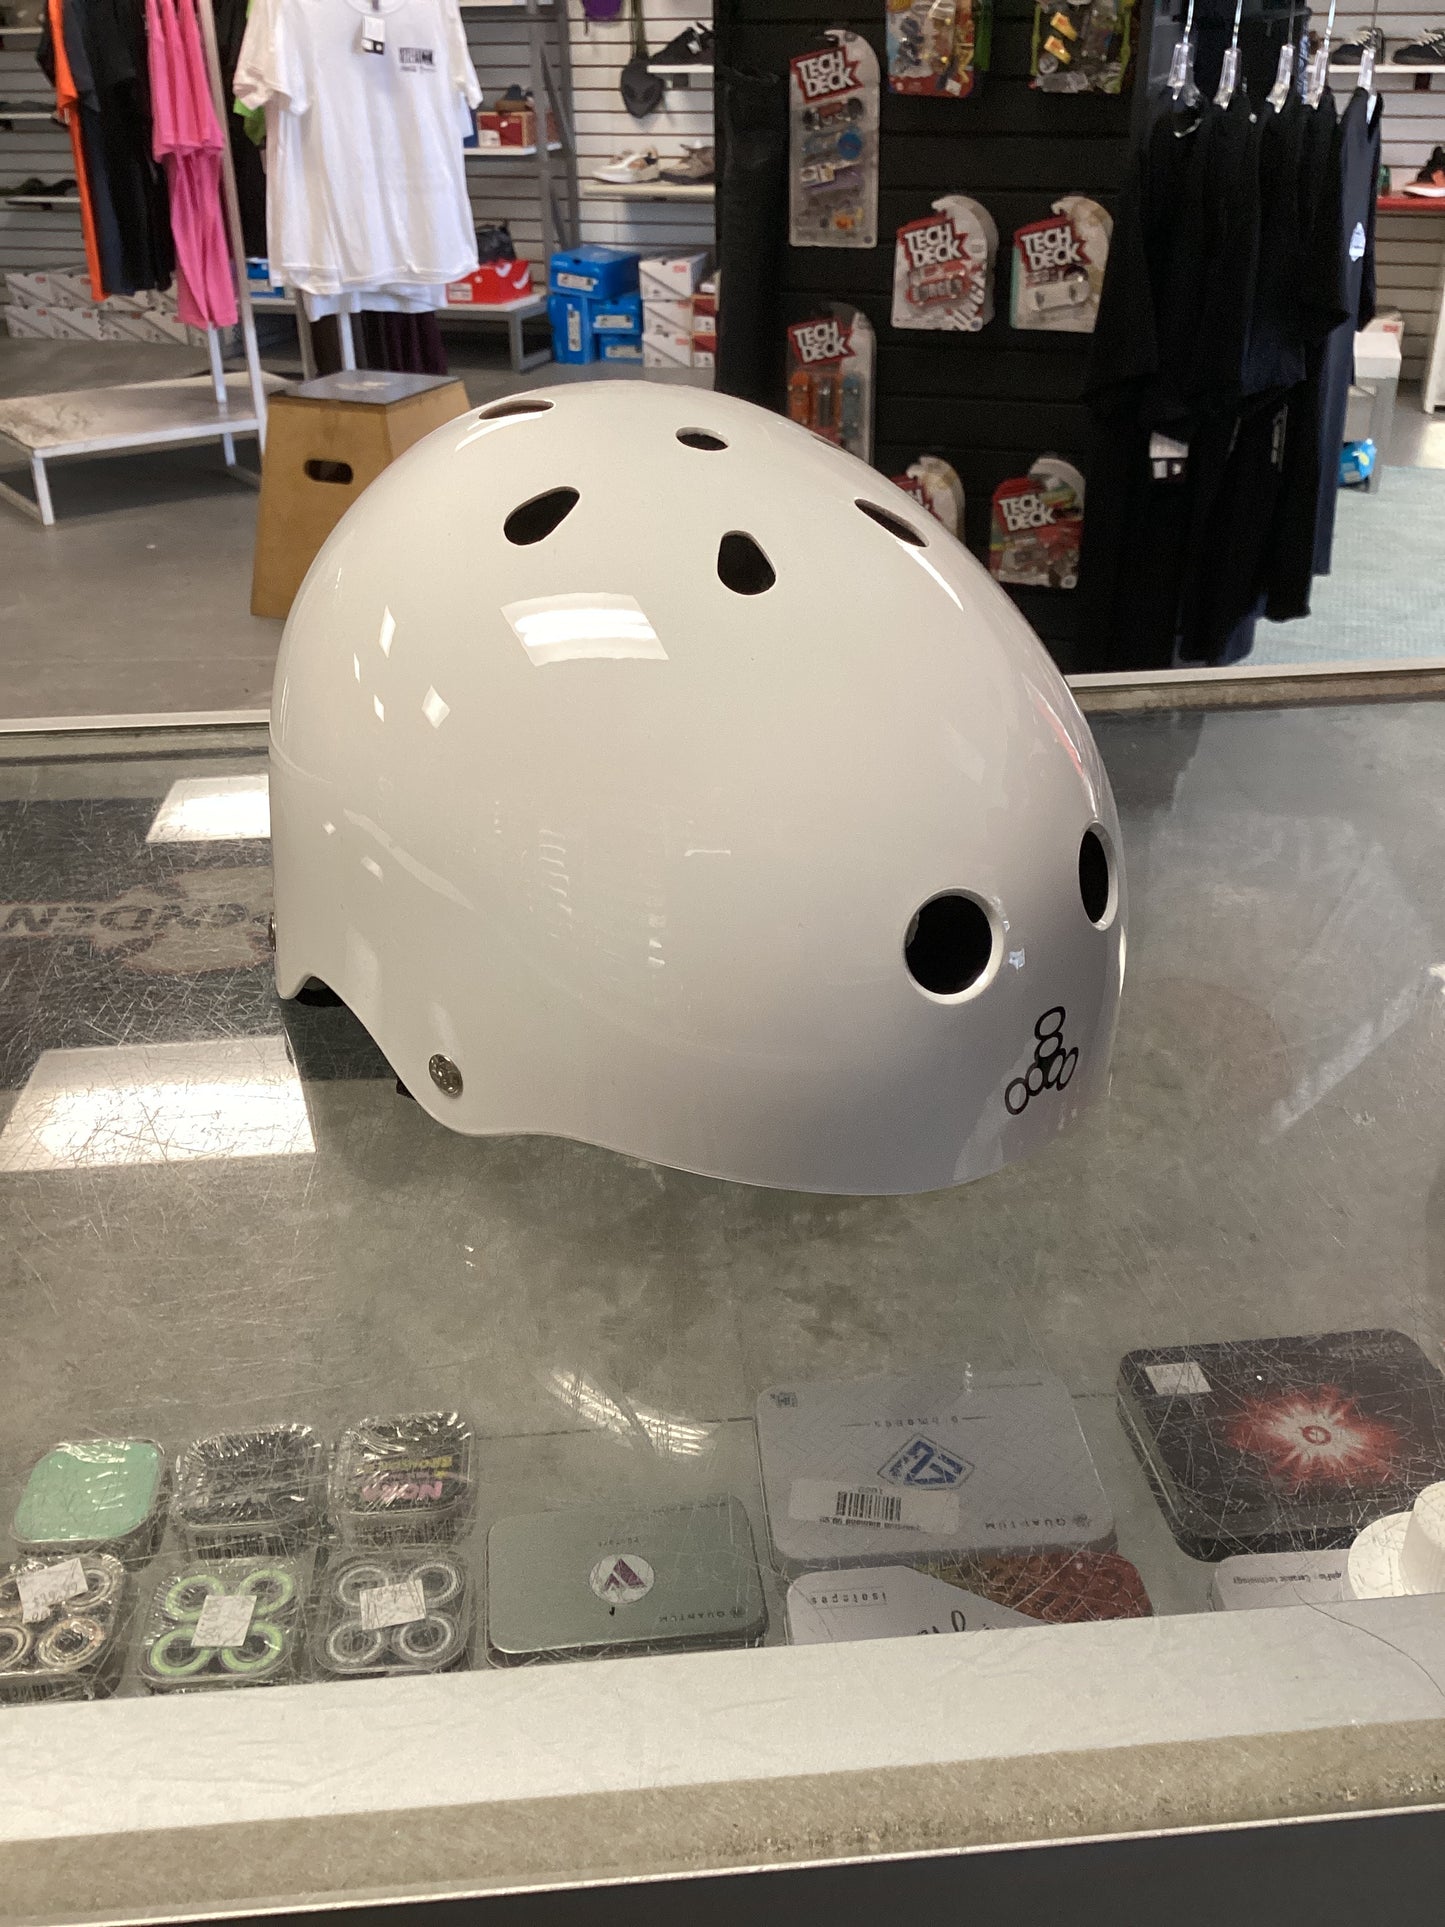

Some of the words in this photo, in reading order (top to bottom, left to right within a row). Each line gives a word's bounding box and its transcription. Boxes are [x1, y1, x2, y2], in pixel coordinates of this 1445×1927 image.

[796, 50, 845, 81] TECH
[806, 67, 856, 98] DECK
[904, 223, 954, 251] TECH
[1020, 225, 1073, 254] TECH
[913, 239, 963, 268] DECK
[1030, 242, 1082, 271] DECK
[793, 321, 840, 348] TECH
[801, 337, 849, 363] DECK
[998, 493, 1045, 517] TECH
[1006, 507, 1057, 532] DECK
